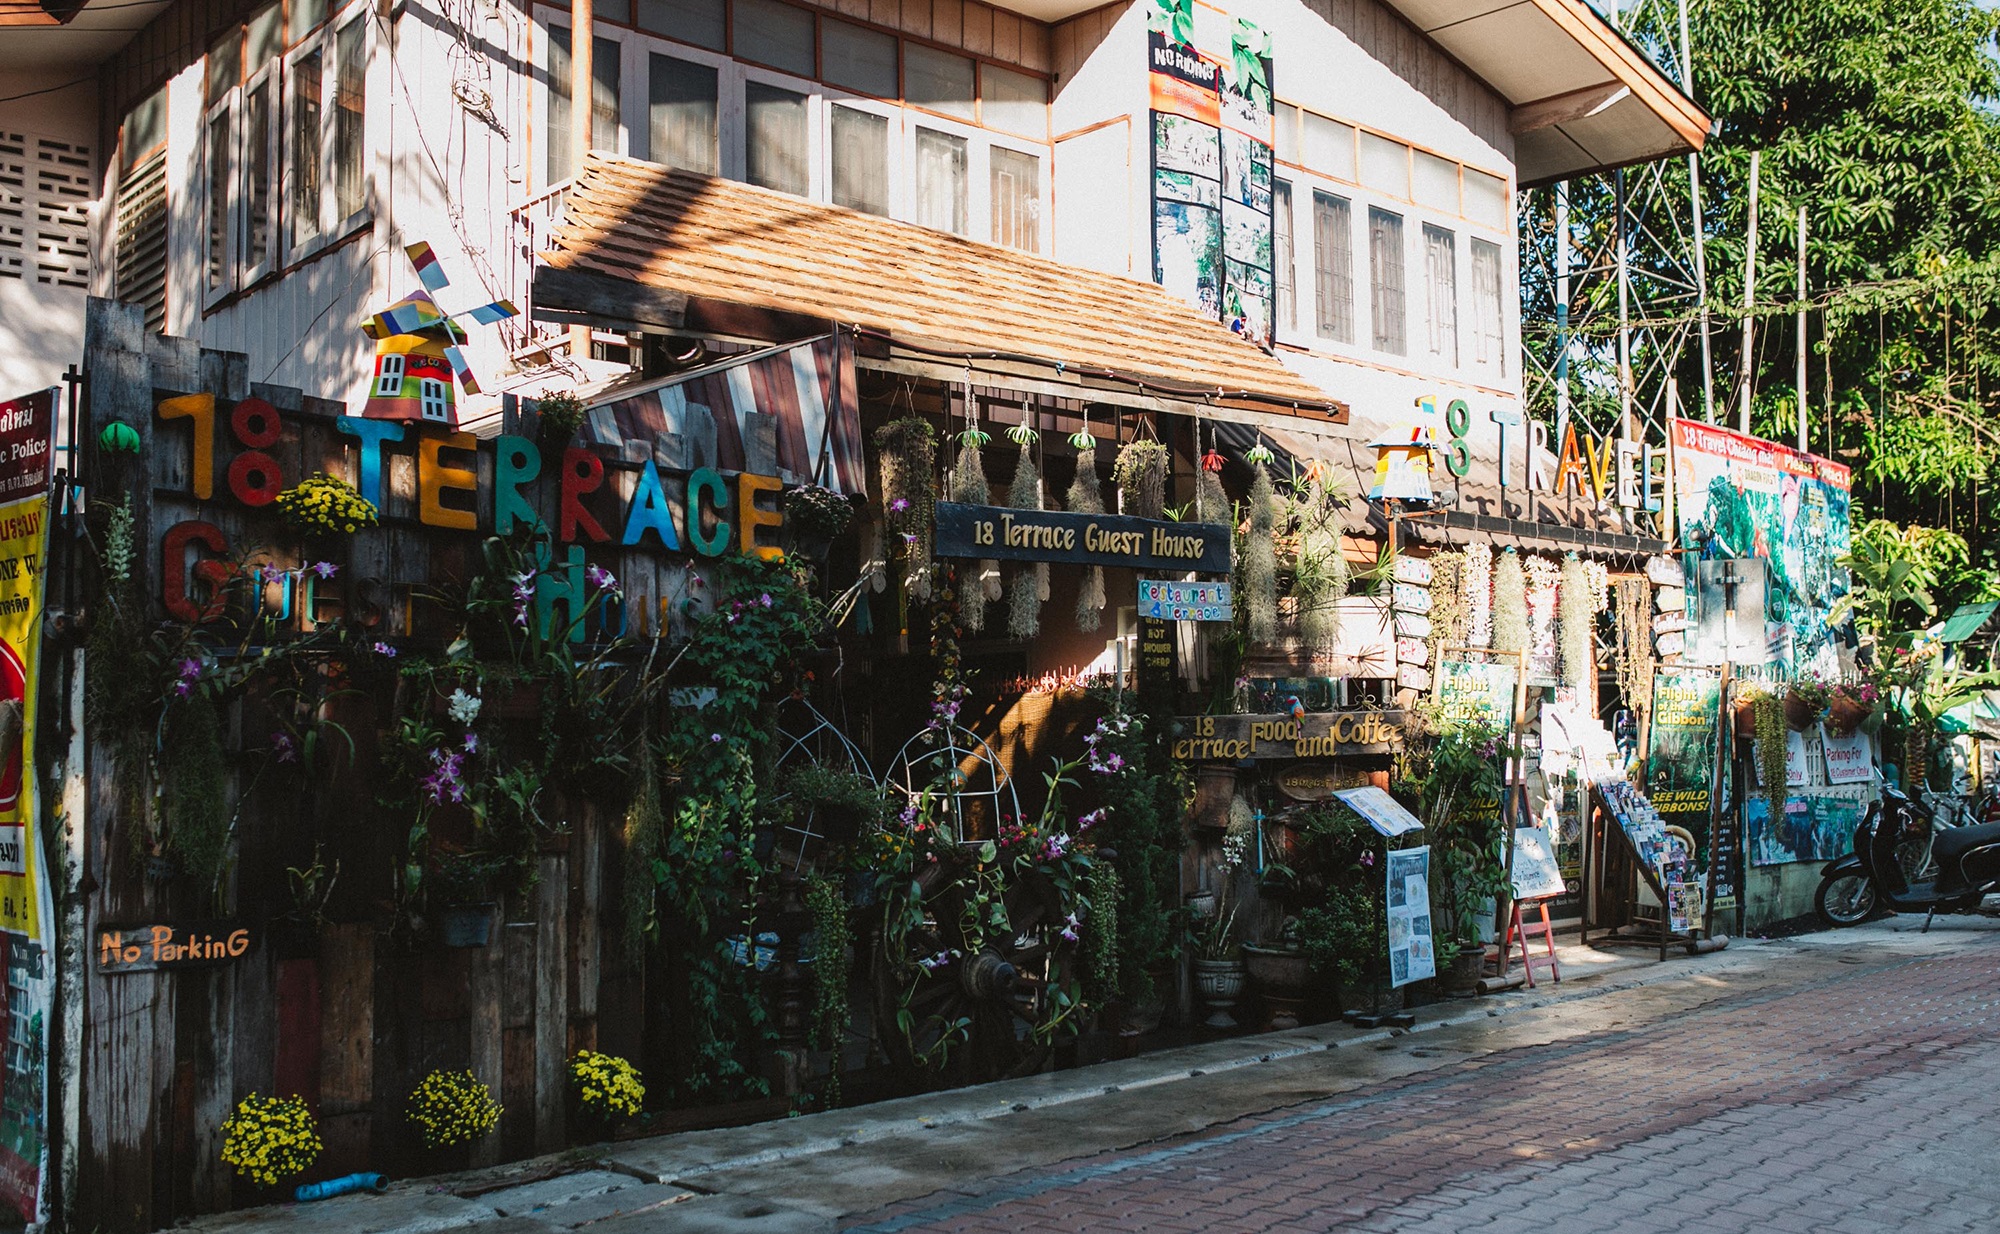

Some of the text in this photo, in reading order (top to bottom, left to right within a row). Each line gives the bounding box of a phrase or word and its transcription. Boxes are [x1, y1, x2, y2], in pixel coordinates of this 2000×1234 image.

[1154, 48, 1214, 80] NO RIDING
[11, 438, 47, 461] Police
[1683, 426, 1696, 447] 18
[1698, 430, 1727, 456] Travel
[1727, 437, 1757, 464] Chiang
[1784, 454, 1813, 474] Please
[1490, 410, 1662, 512] TRAVEL
[157, 392, 785, 564] 18 TERRACE
[974, 520, 995, 546] 18
[1001, 513, 1075, 551] Terrace
[1152, 527, 1204, 559] House
[1140, 581, 1224, 604] Restaurant
[1165, 603, 1221, 620] Terrace
[1147, 629, 1165, 639] HOT
[1143, 642, 1172, 653] SHOWER
[1444, 677, 1490, 694] Flight
[1443, 694, 1457, 703] of
[1658, 687, 1697, 702] Flight
[1658, 701, 1687, 712] of the
[1195, 716, 1216, 737] 18
[1657, 711, 1706, 725] Gibbon
[1251, 721, 1299, 752] Food
[1295, 726, 1336, 757] and
[1334, 712, 1404, 745] Coffee
[1786, 751, 1795, 762] or
[1826, 746, 1862, 763] Parking For
[1836, 767, 1855, 777] Customer
[1856, 766, 1869, 777] Only
[1652, 790, 1709, 803] SEE WILD
[1652, 801, 1710, 813] GIBBONS!
[101, 931, 141, 967] No
